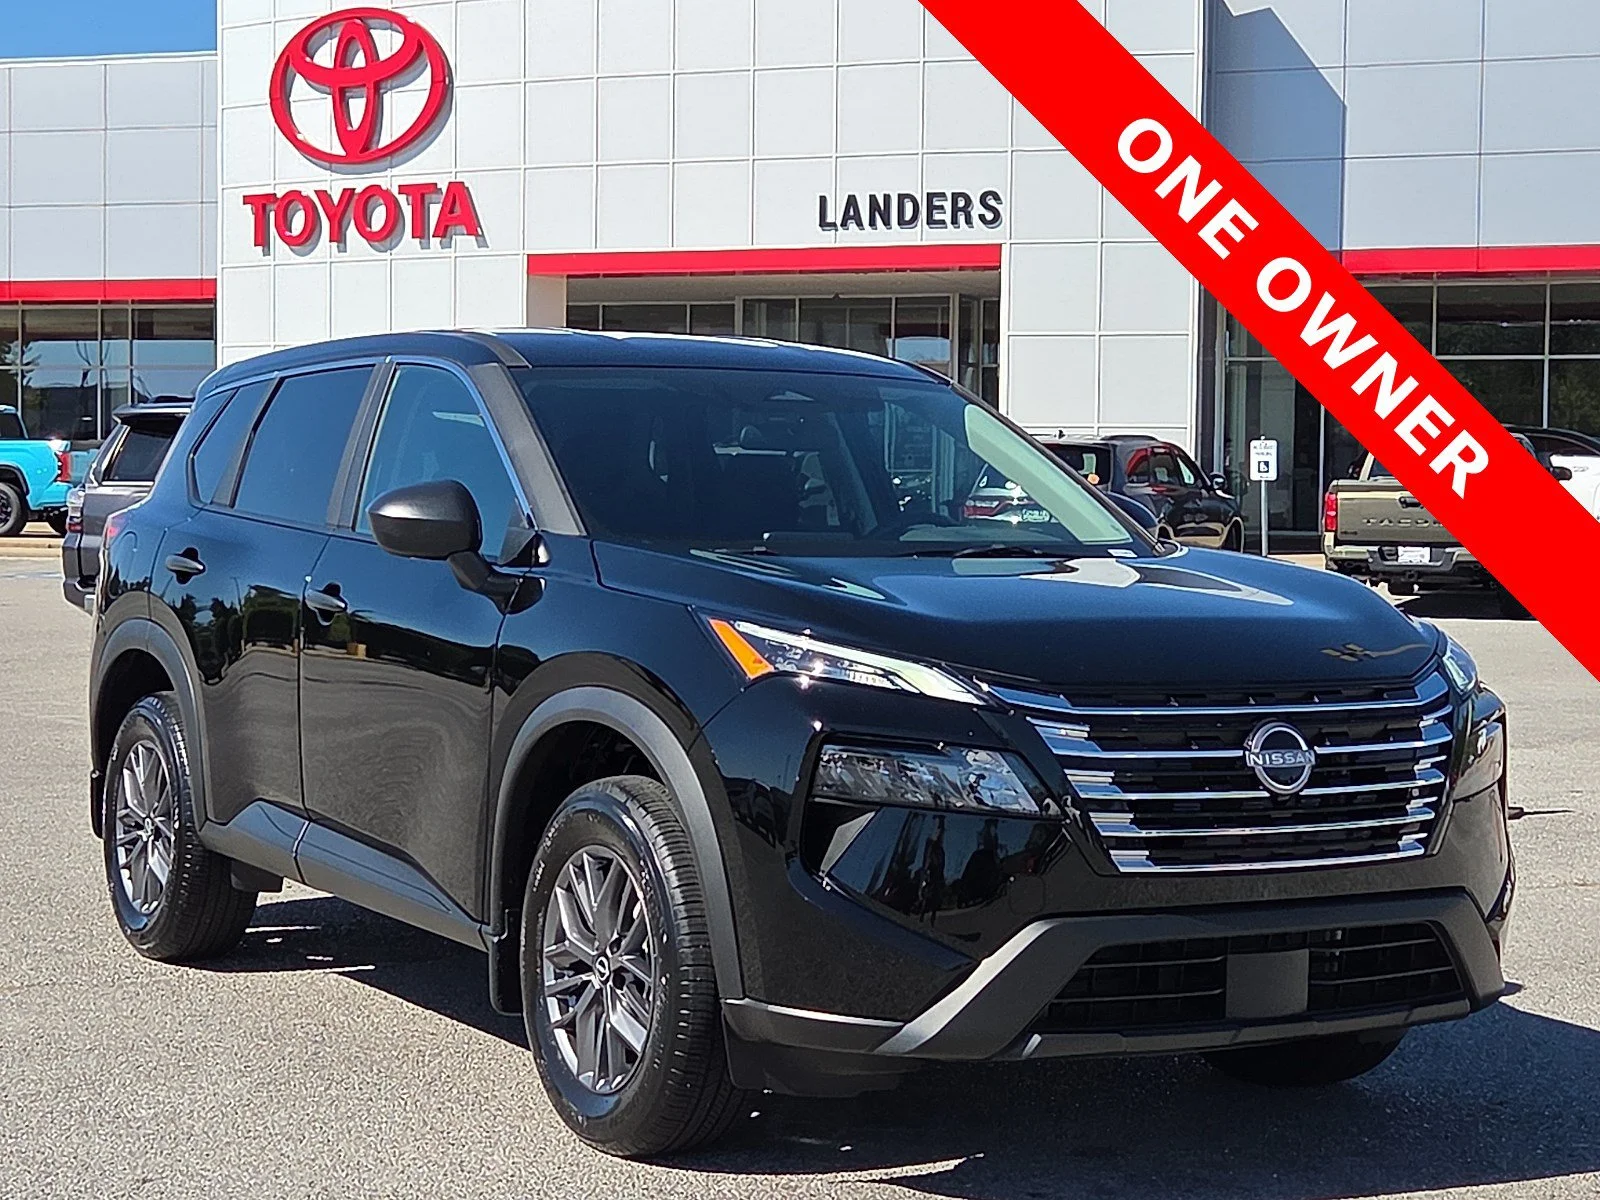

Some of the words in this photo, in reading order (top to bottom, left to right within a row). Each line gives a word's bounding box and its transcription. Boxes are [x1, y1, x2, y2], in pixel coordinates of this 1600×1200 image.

[243, 181, 480, 247] TOYOTA
[818, 190, 1003, 230] LANDERS
[1249, 751, 1315, 765] NISSAN
